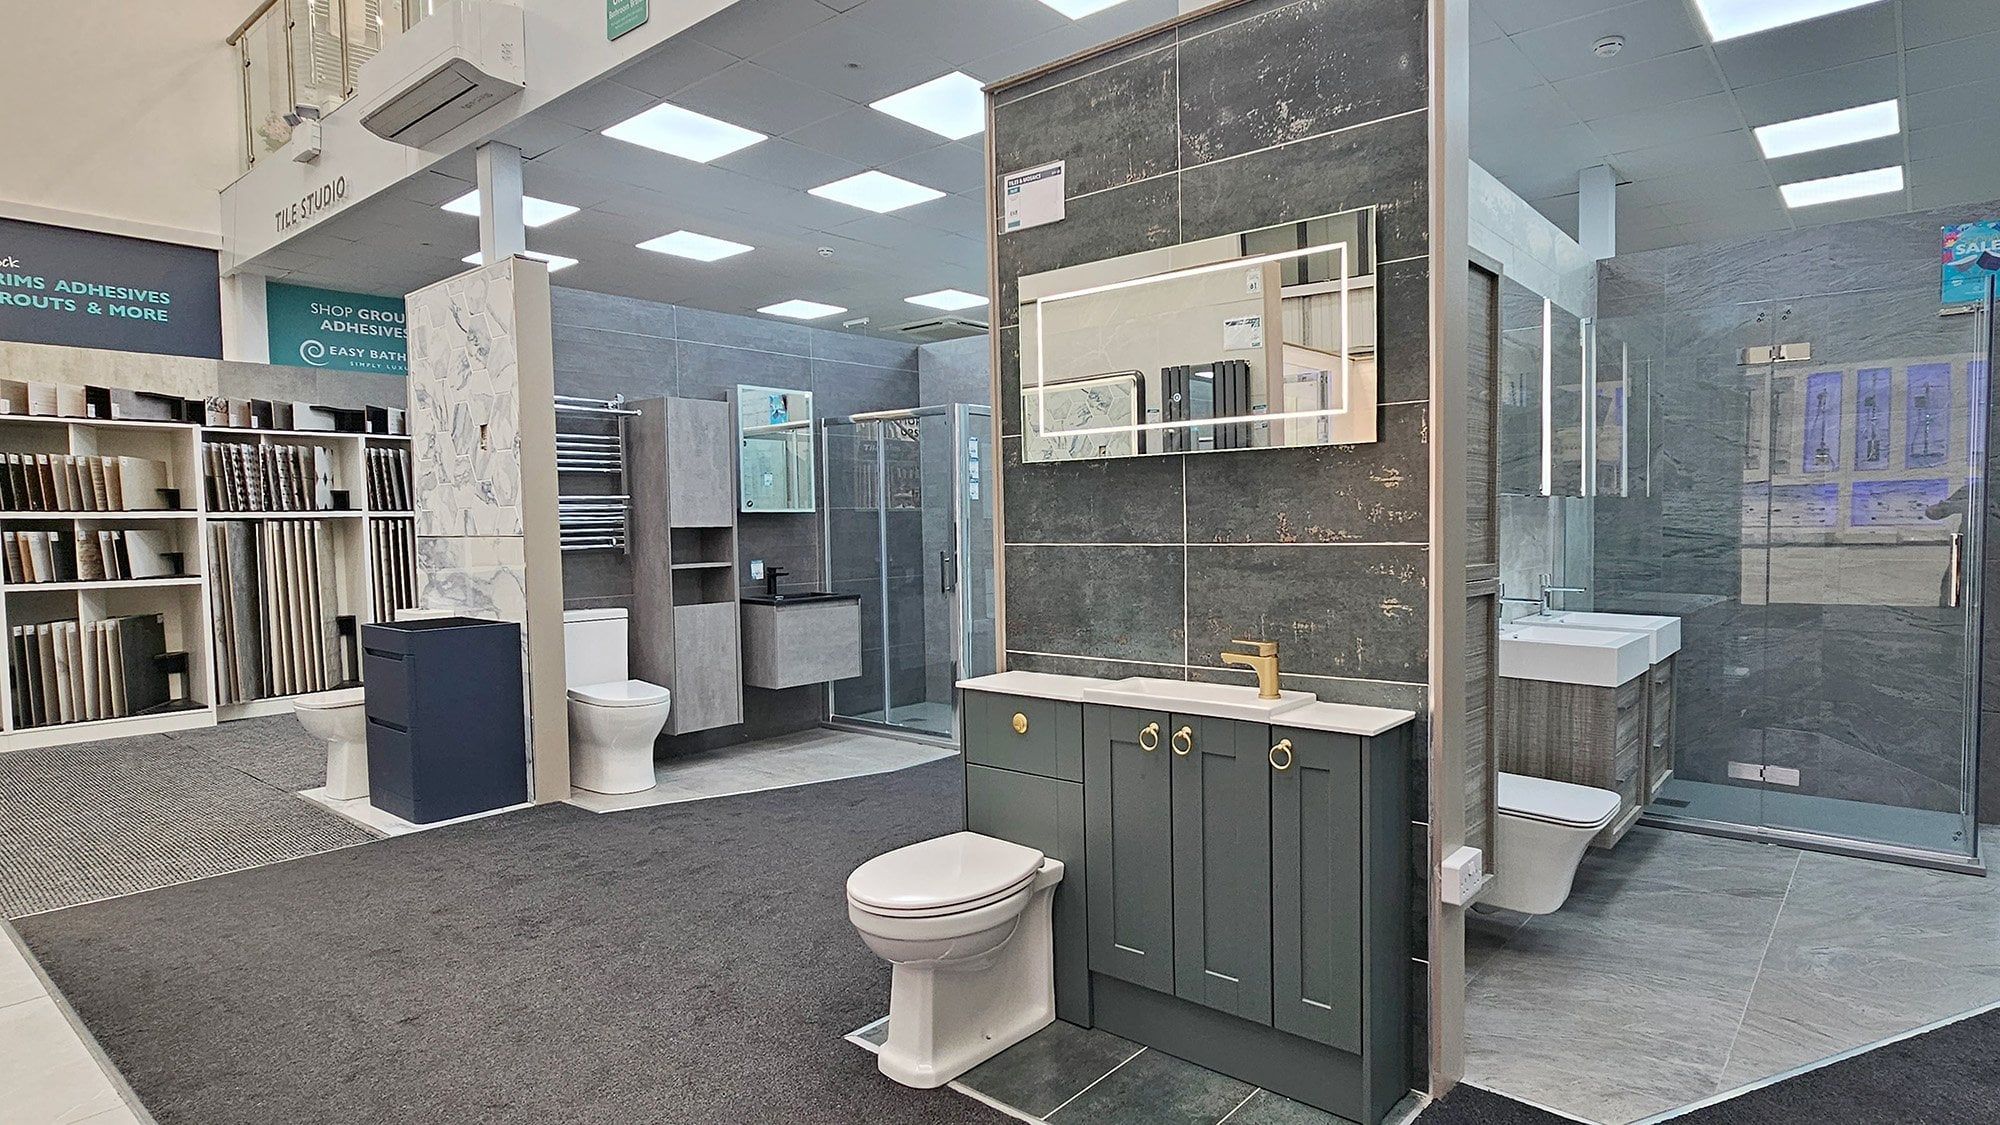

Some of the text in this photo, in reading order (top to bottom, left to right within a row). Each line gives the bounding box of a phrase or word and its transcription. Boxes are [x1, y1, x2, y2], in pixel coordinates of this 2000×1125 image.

[275, 175, 345, 232] TILE STUDIO
[1955, 240, 2000, 255] SALE
[54, 279, 170, 304] ADHESIVES
[0, 291, 168, 322] ROUTS & MORE
[310, 302, 353, 318] SHOP
[320, 319, 408, 339] ADHESIVES
[329, 345, 365, 358] EASY
